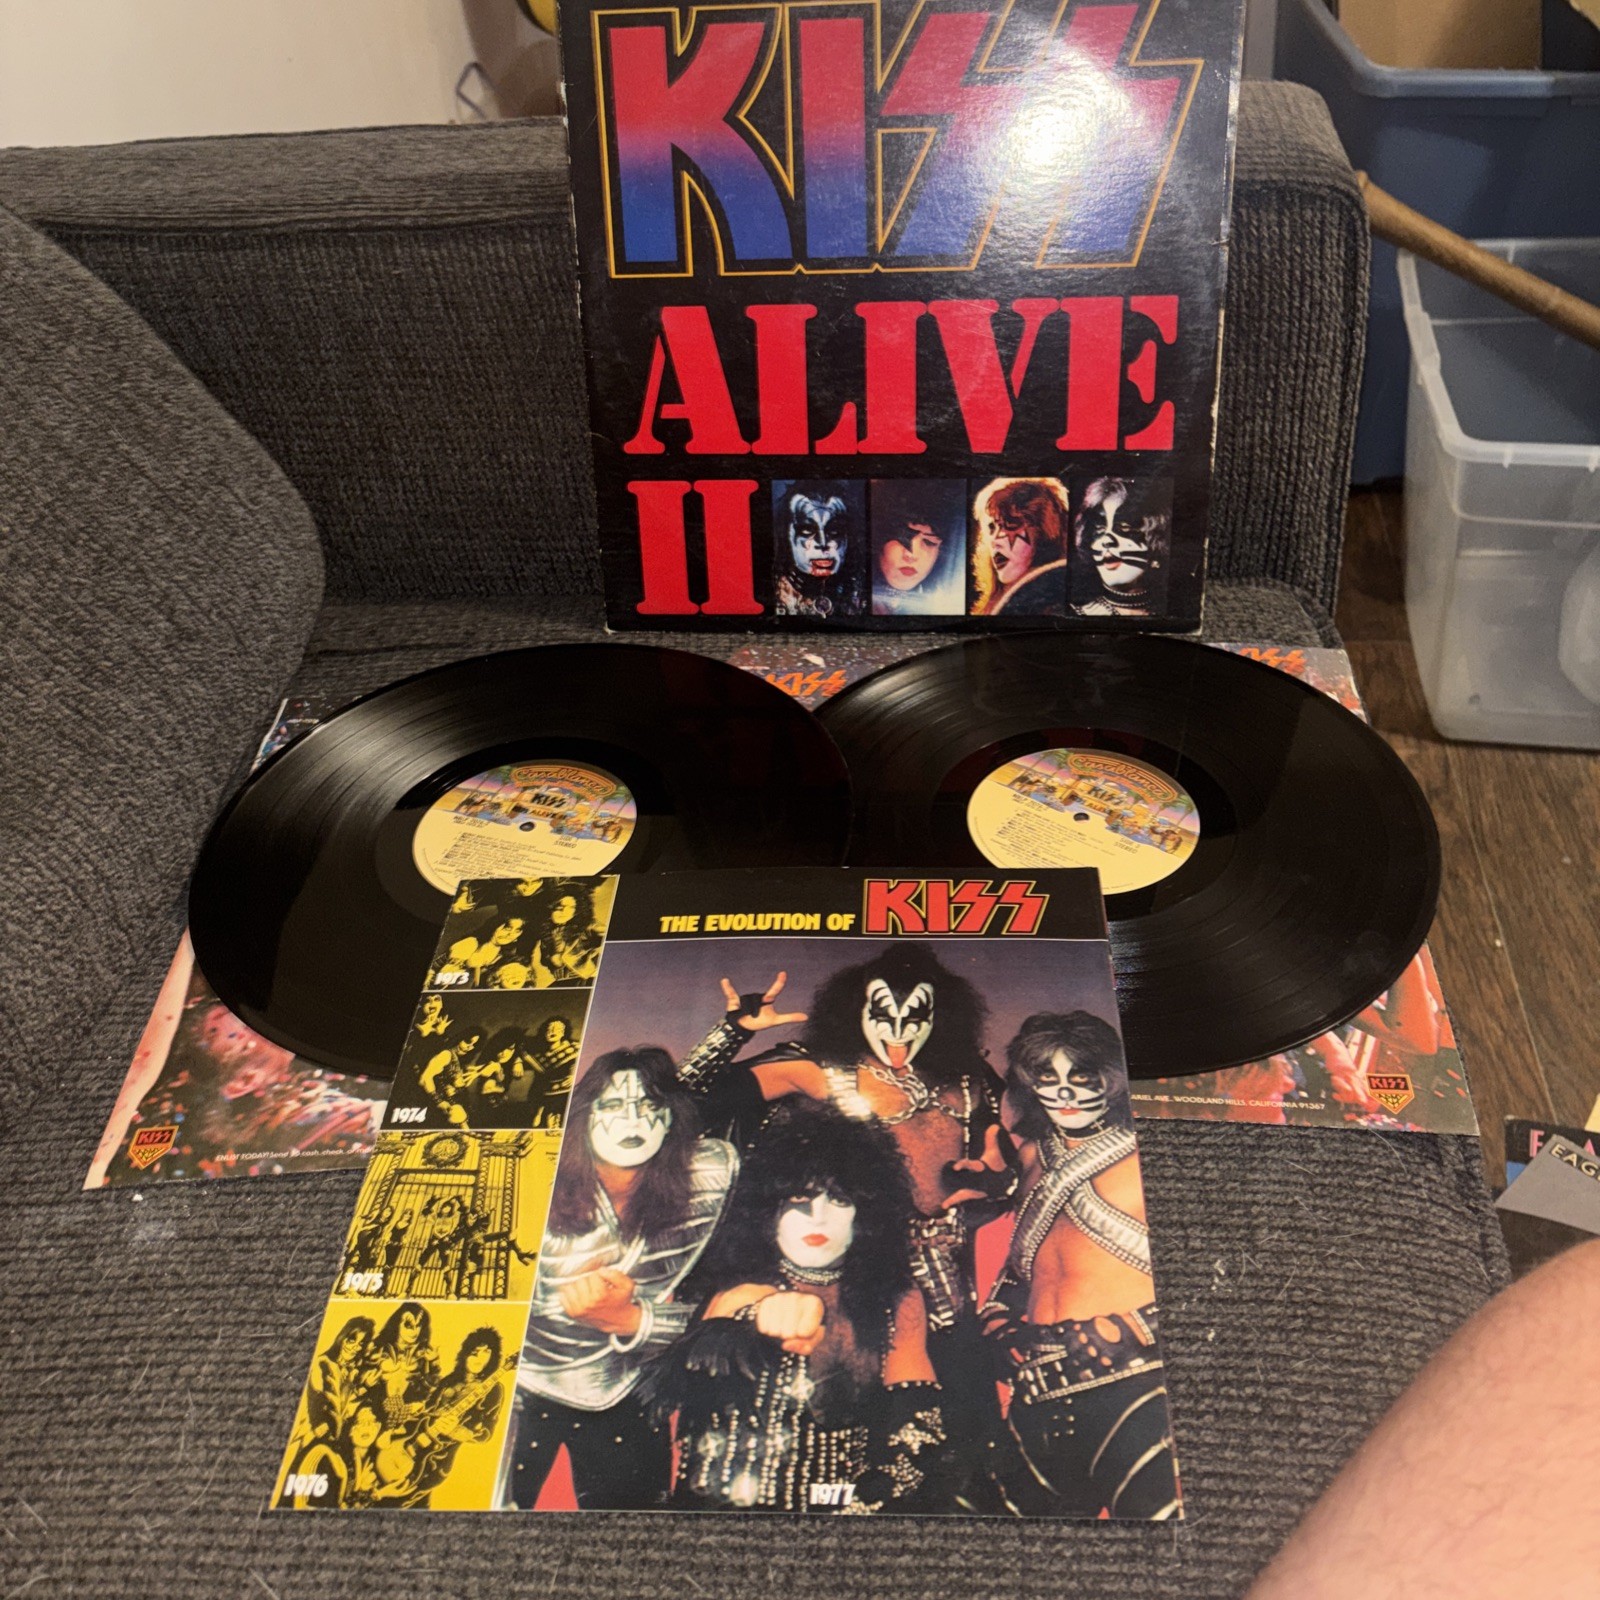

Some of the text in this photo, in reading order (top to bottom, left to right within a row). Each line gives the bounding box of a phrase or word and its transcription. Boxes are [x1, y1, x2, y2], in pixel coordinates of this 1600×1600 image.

[591, 0, 1204, 278] KISS
[623, 295, 1179, 455] ALIVE
[627, 479, 764, 615] II
[531, 793, 567, 808] KISS
[1088, 786, 1124, 806] KISS
[554, 840, 577, 849] STEREO
[1113, 841, 1138, 854] STEREO
[660, 878, 1050, 935] THE EVOLUTION OF KISS
[433, 972, 470, 985] 1973
[1370, 1077, 1406, 1089] KISS
[1173, 1096, 1224, 1105] WOODLAND
[1248, 1099, 1298, 1109] CALIFORNIA
[391, 1106, 428, 1123] 1974
[137, 1131, 172, 1145] KISS
[1551, 1143, 1600, 1182] EAG
[340, 1272, 384, 1294] 1975
[283, 1473, 329, 1498] 1976
[809, 1483, 857, 1506] 1977
